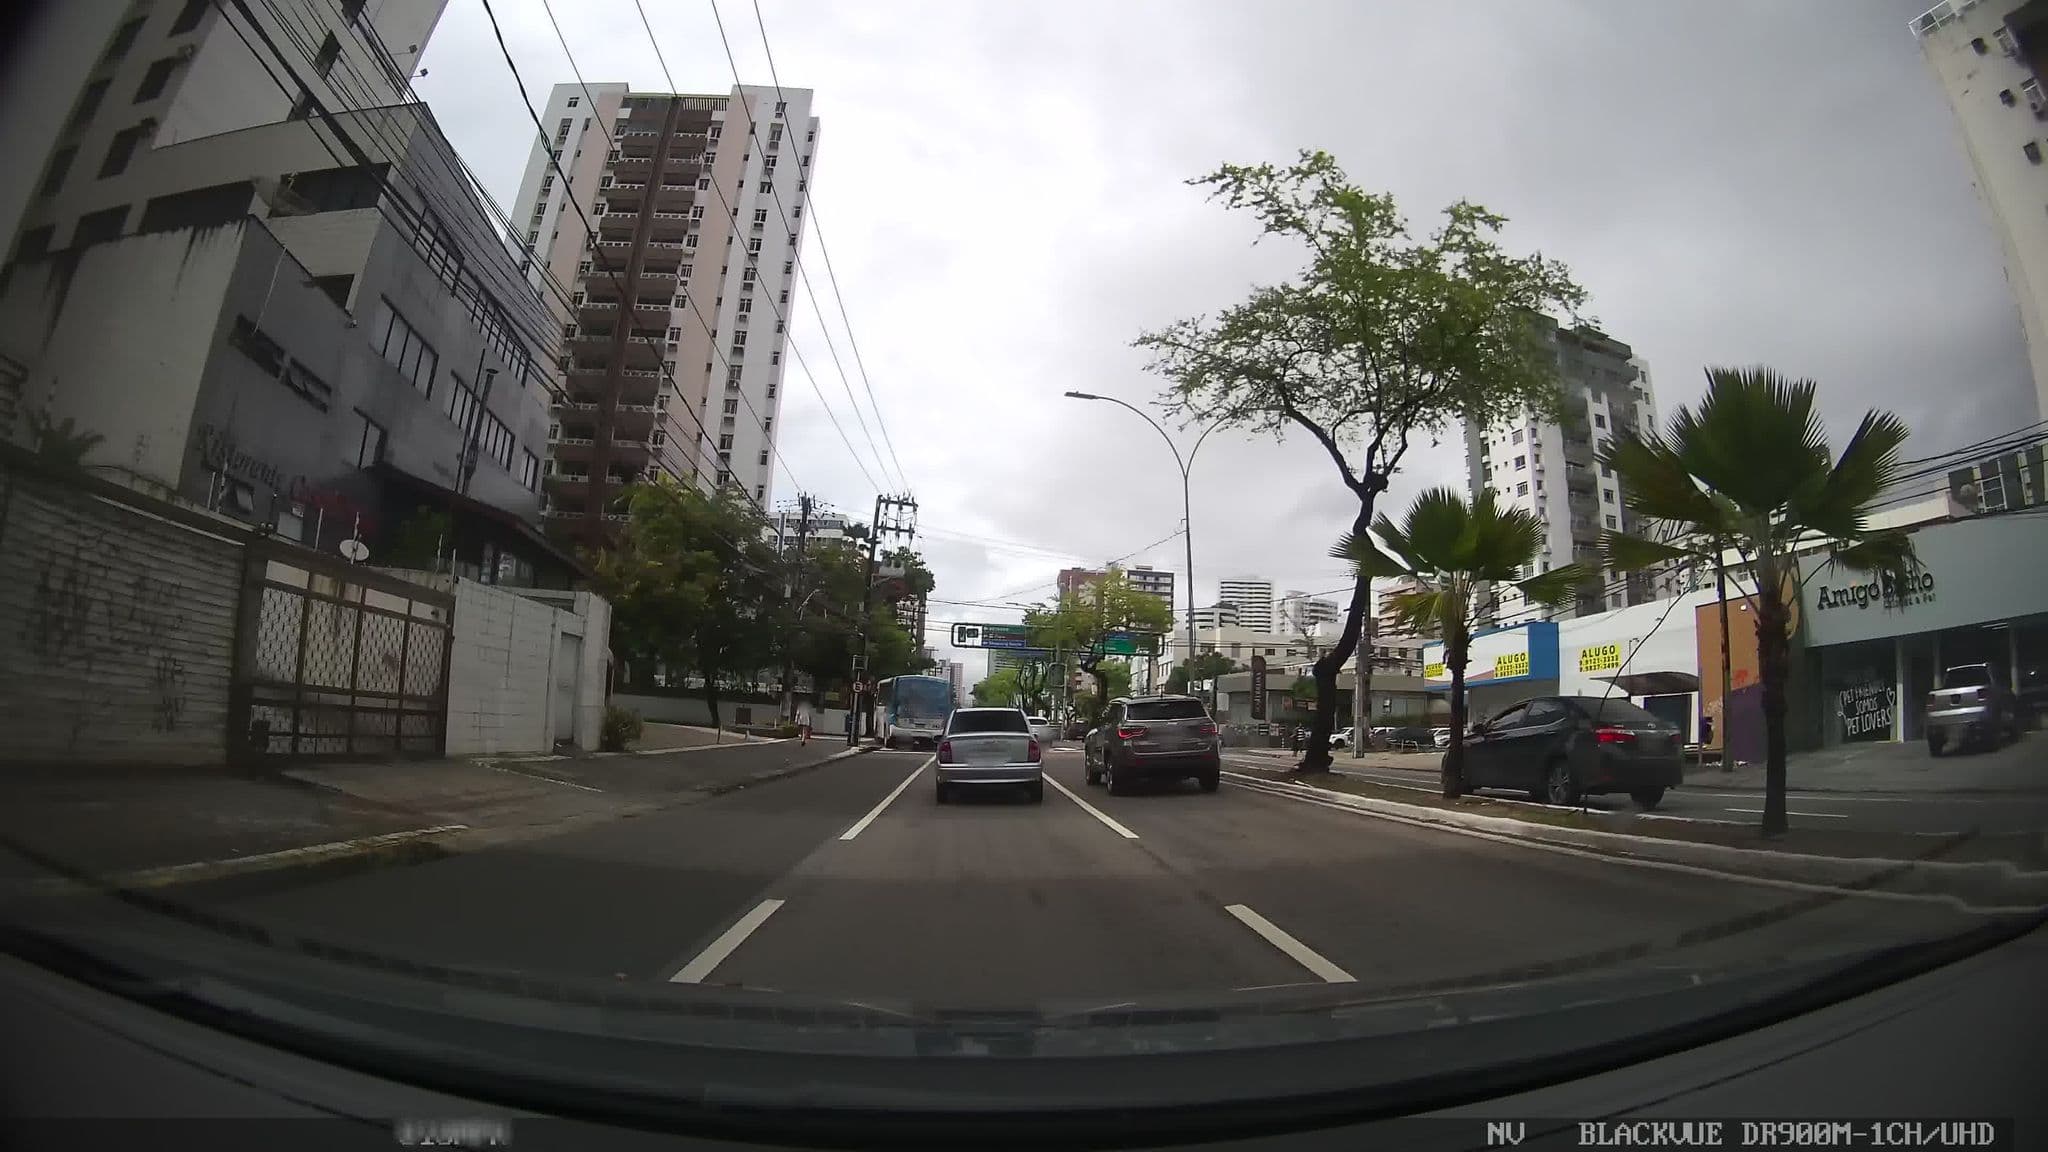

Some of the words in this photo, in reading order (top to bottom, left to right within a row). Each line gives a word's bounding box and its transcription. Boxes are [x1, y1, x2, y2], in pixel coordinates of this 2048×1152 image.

[1497, 652, 1526, 665] ALUGO
[1582, 645, 1616, 659] ALUGO
[1855, 697, 1878, 715] SOMOS
[1847, 716, 1860, 736] PET
[1861, 708, 1892, 732] LOVERS
